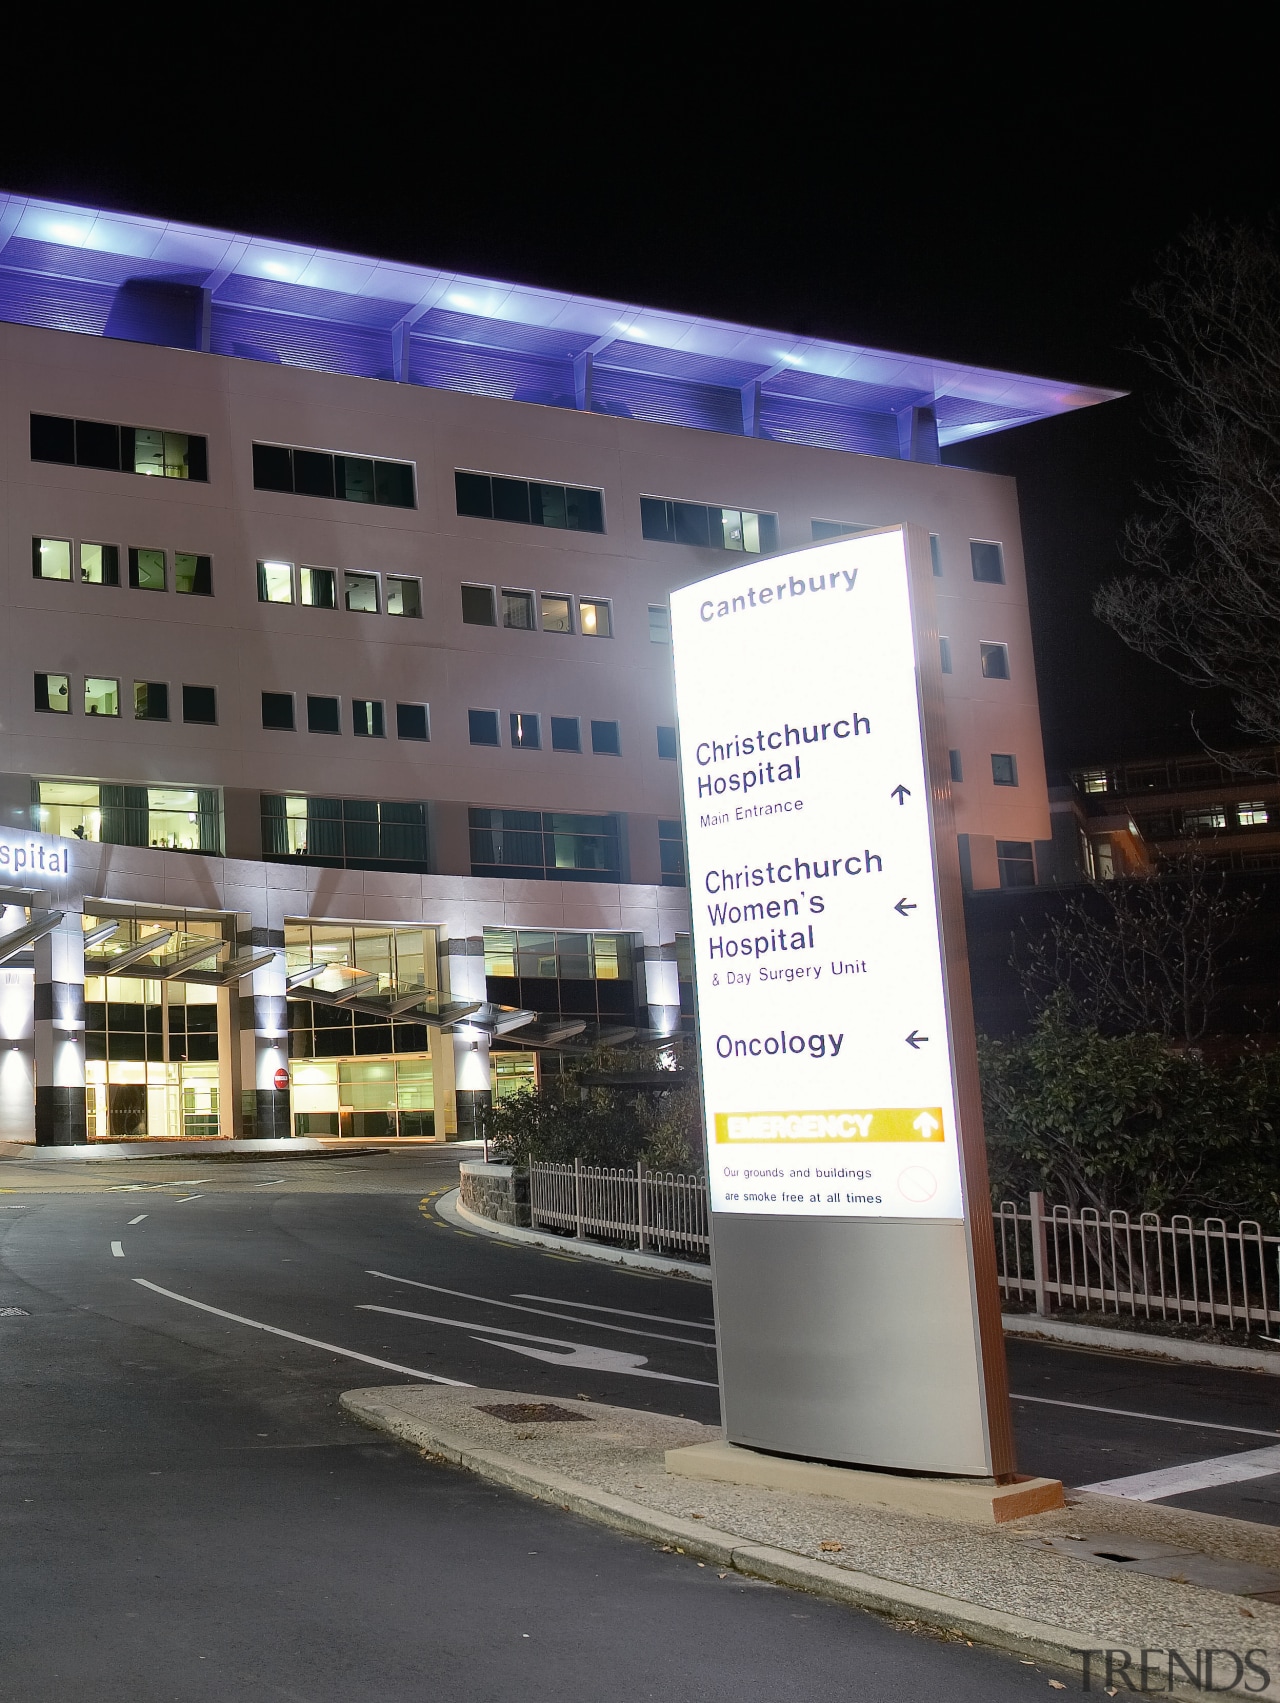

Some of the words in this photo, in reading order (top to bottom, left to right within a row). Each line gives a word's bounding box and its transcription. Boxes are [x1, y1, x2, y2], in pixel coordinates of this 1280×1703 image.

[698, 567, 859, 623] Canterbury
[695, 712, 871, 767] Christchurch
[696, 755, 802, 799] Hospital
[699, 811, 730, 829] Main
[735, 798, 804, 821] Entrance
[705, 849, 883, 894] Christchurch
[707, 891, 825, 927] Women's
[709, 924, 815, 959] Hospital
[711, 972, 720, 987] &
[726, 971, 752, 986] Day
[759, 965, 822, 983] Surgery
[831, 959, 868, 977] Unit
[716, 1030, 844, 1059] Oncology
[727, 1114, 873, 1139] EMERGENCY
[723, 1166, 739, 1178] Our
[743, 1167, 785, 1180] grounds
[789, 1167, 811, 1178] and
[816, 1167, 872, 1181] buildings
[724, 1191, 740, 1201] are
[743, 1191, 777, 1202] smoke
[781, 1191, 804, 1203] free
[809, 1192, 822, 1203] at
[826, 1192, 841, 1203] all
[846, 1192, 882, 1204] times
